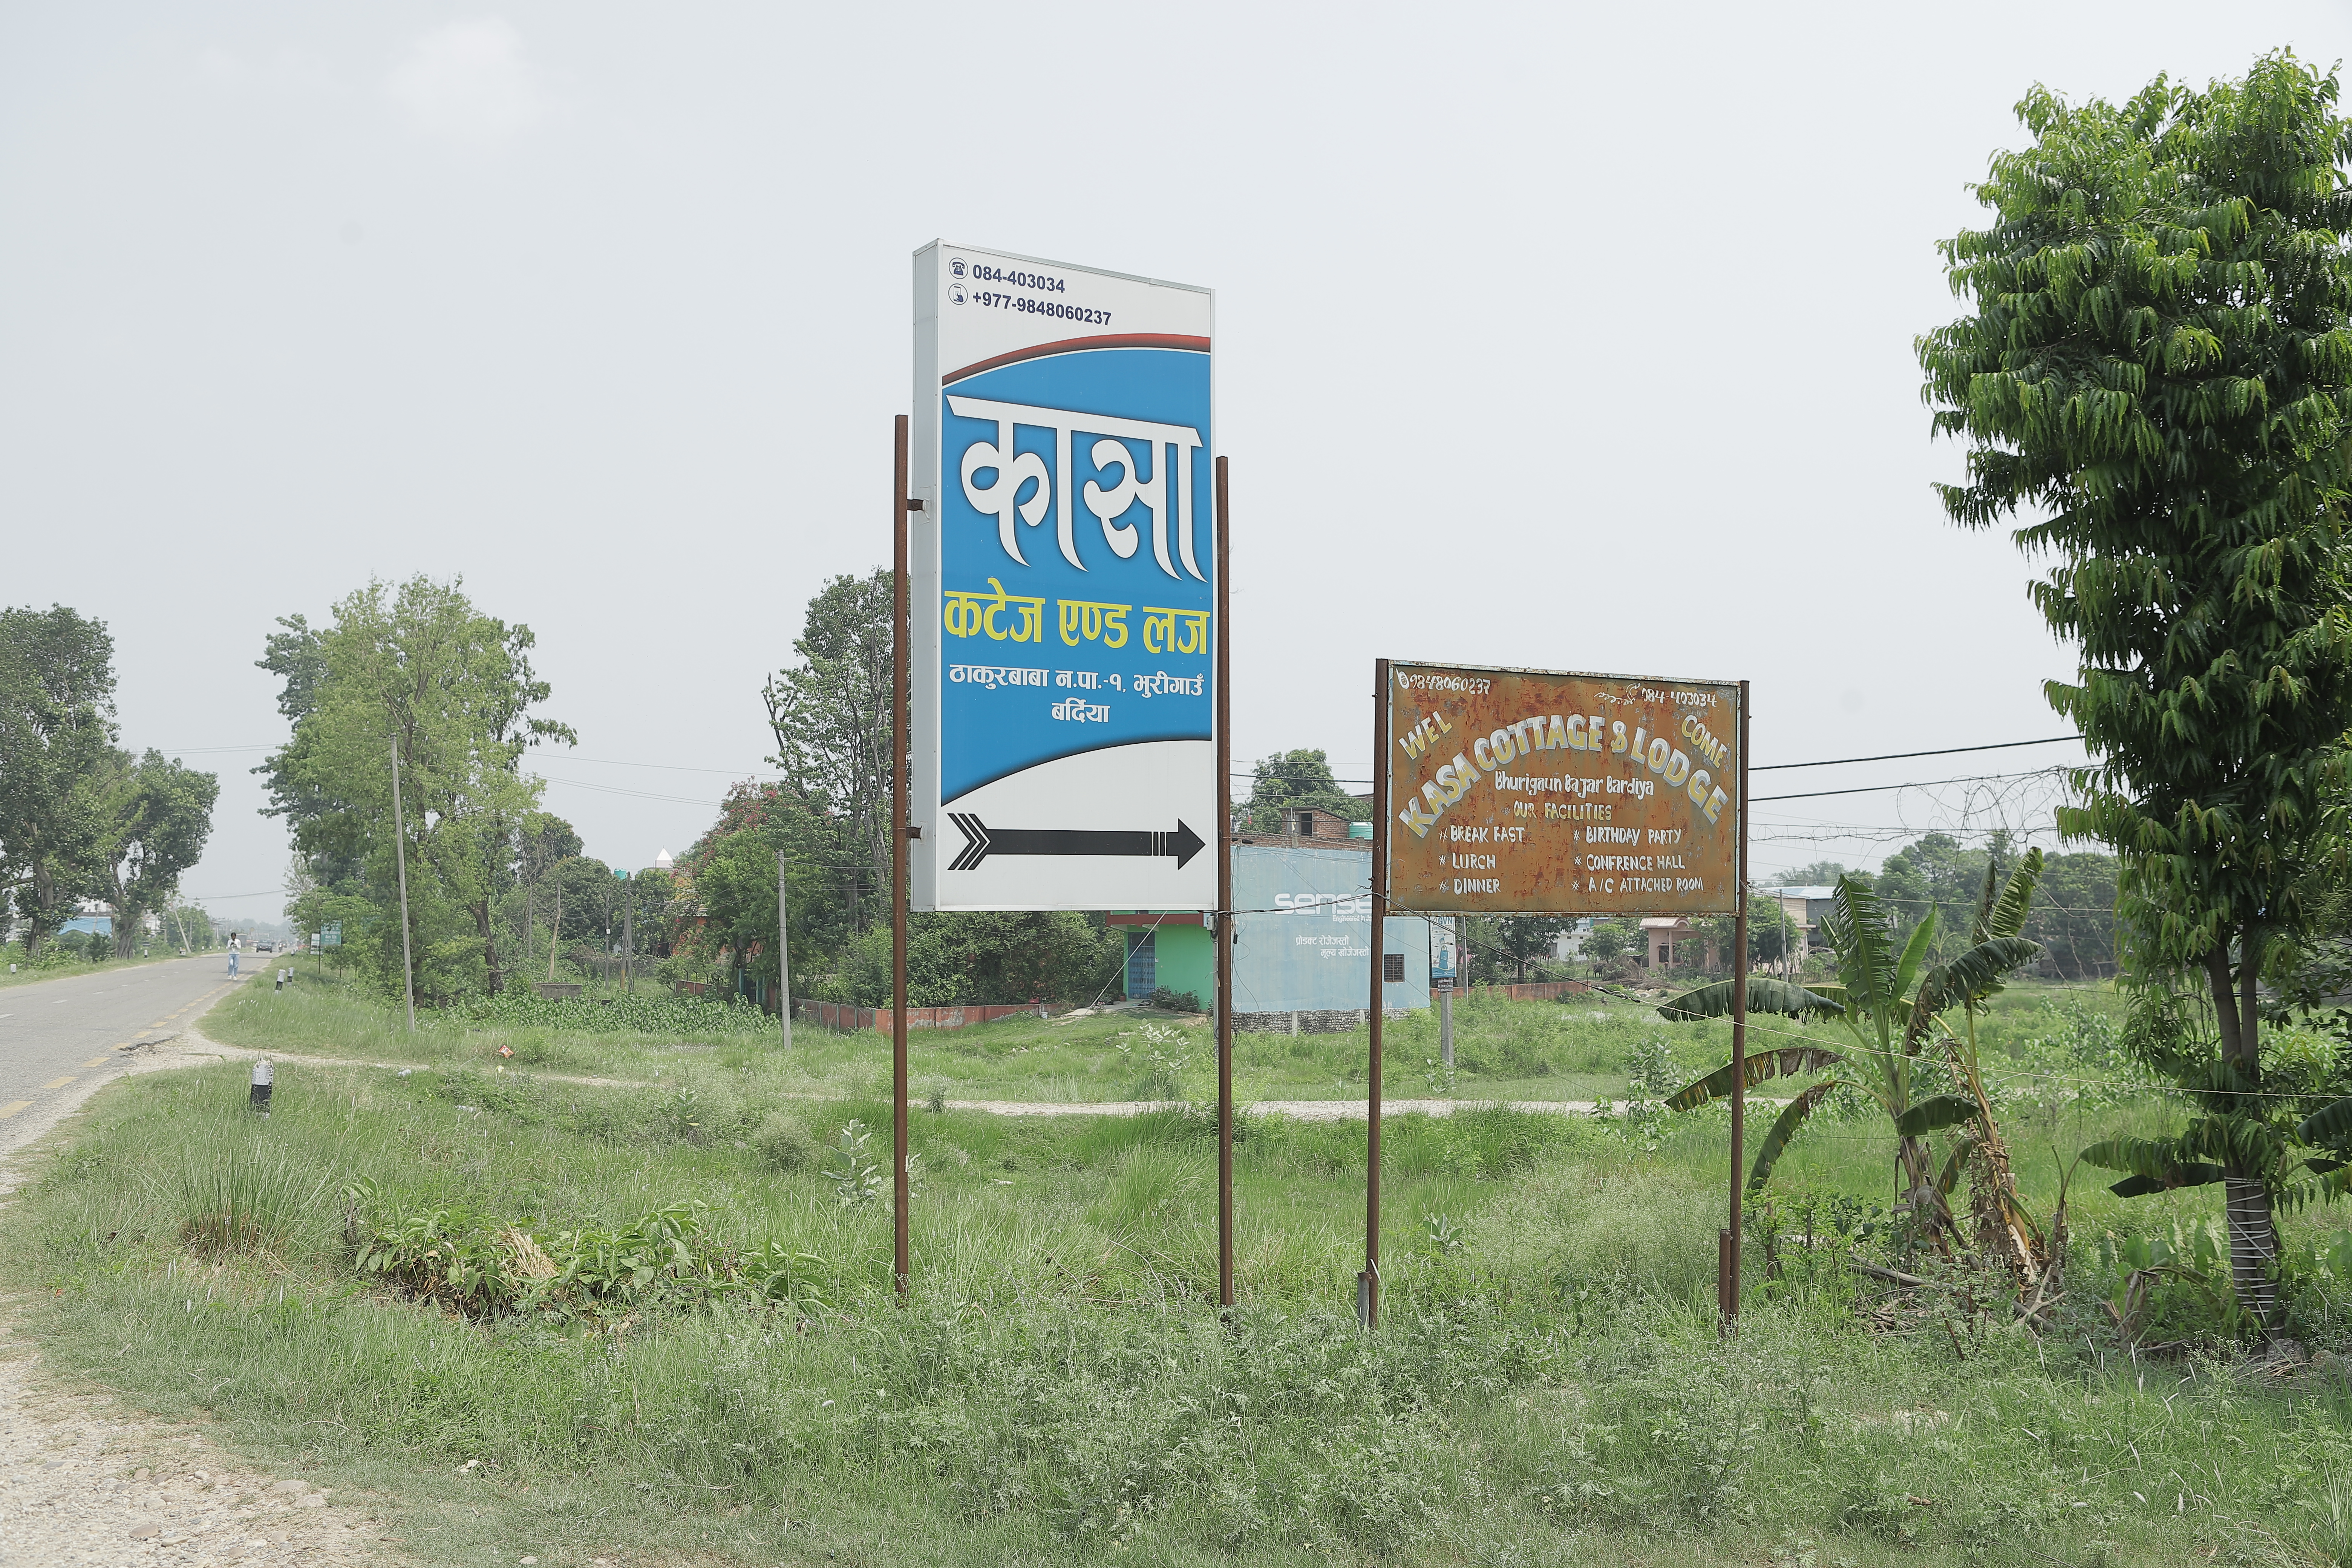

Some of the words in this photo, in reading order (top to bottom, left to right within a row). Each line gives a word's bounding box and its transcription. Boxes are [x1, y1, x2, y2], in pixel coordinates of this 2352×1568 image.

[973, 265, 1065, 293] 084-403034
[973, 291, 1112, 326] +977-9848060237
[946, 395, 1208, 583] कासा
[944, 578, 1046, 643] कटेज
[1057, 599, 1132, 648] एण्ड
[1142, 606, 1210, 654] लज
[949, 664, 1049, 690] ठाकुरबाबा
[1133, 671, 1204, 698] भुरीगाउँ
[1410, 674, 1490, 695] 9848060237
[1051, 697, 1110, 723] बर्दिया
[1398, 710, 1453, 760] WEL
[1681, 715, 1727, 769] COME
[1398, 752, 1481, 838] KASA
[1473, 714, 1605, 772] COTTAGE
[1611, 720, 1628, 753] &
[1631, 726, 1729, 825] LODGE
[1494, 770, 1562, 796] Bhurigaun
[1606, 775, 1654, 800] Bardiya
[1513, 800, 1537, 819] OUR
[1544, 802, 1612, 821] FACILITIES
[1450, 825, 1489, 844] BREAK
[1494, 826, 1525, 842] FAST
[1586, 826, 1640, 847] BIRTHDAY
[1648, 828, 1682, 845] PARTY
[1586, 854, 1654, 871] CONFRENCE
[1657, 854, 1686, 870] HALL
[1453, 878, 1501, 895] DINNER
[1620, 877, 1672, 893] ATTACHED
[1675, 876, 1704, 892] ROOM
